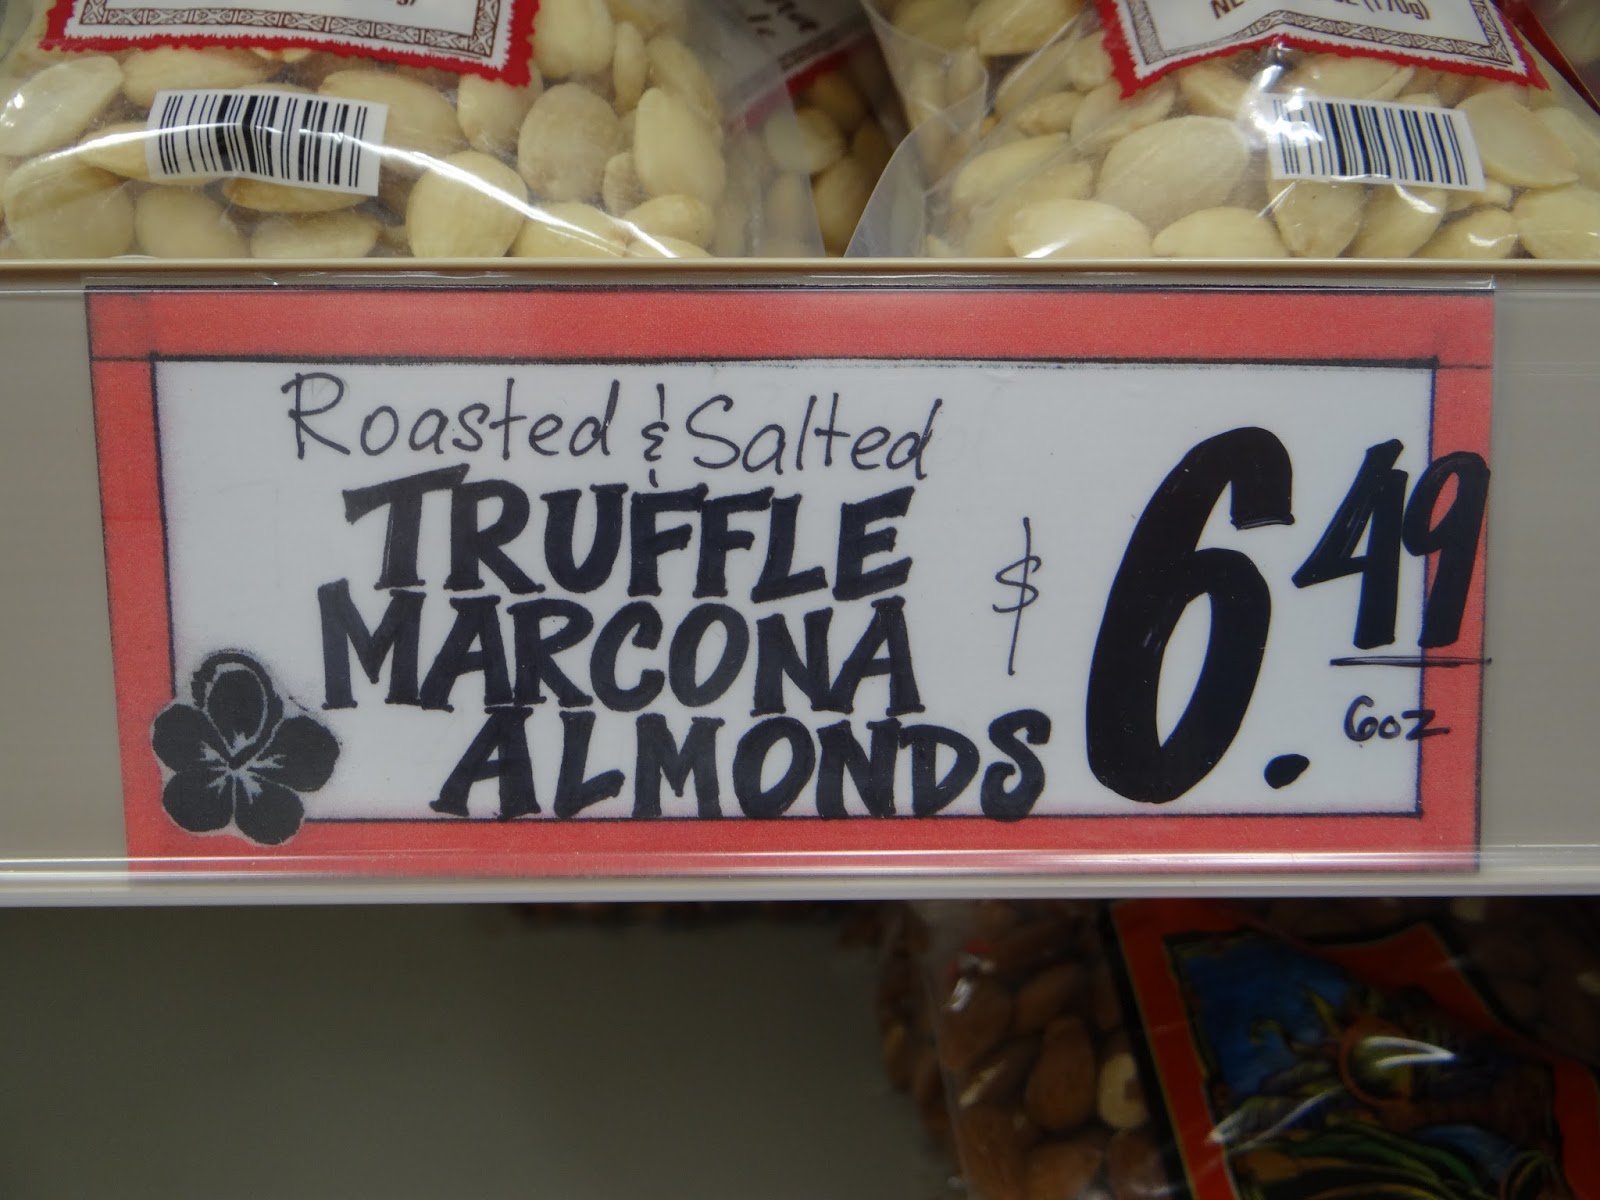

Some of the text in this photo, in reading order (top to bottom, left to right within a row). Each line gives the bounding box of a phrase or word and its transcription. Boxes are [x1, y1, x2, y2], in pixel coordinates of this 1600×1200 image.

[281, 372, 621, 461] Roasted
[685, 394, 944, 480] Salted
[342, 463, 917, 604] TRUFFLE
[320, 578, 926, 716] MARCONA
[429, 708, 1053, 822] ALMONDS
